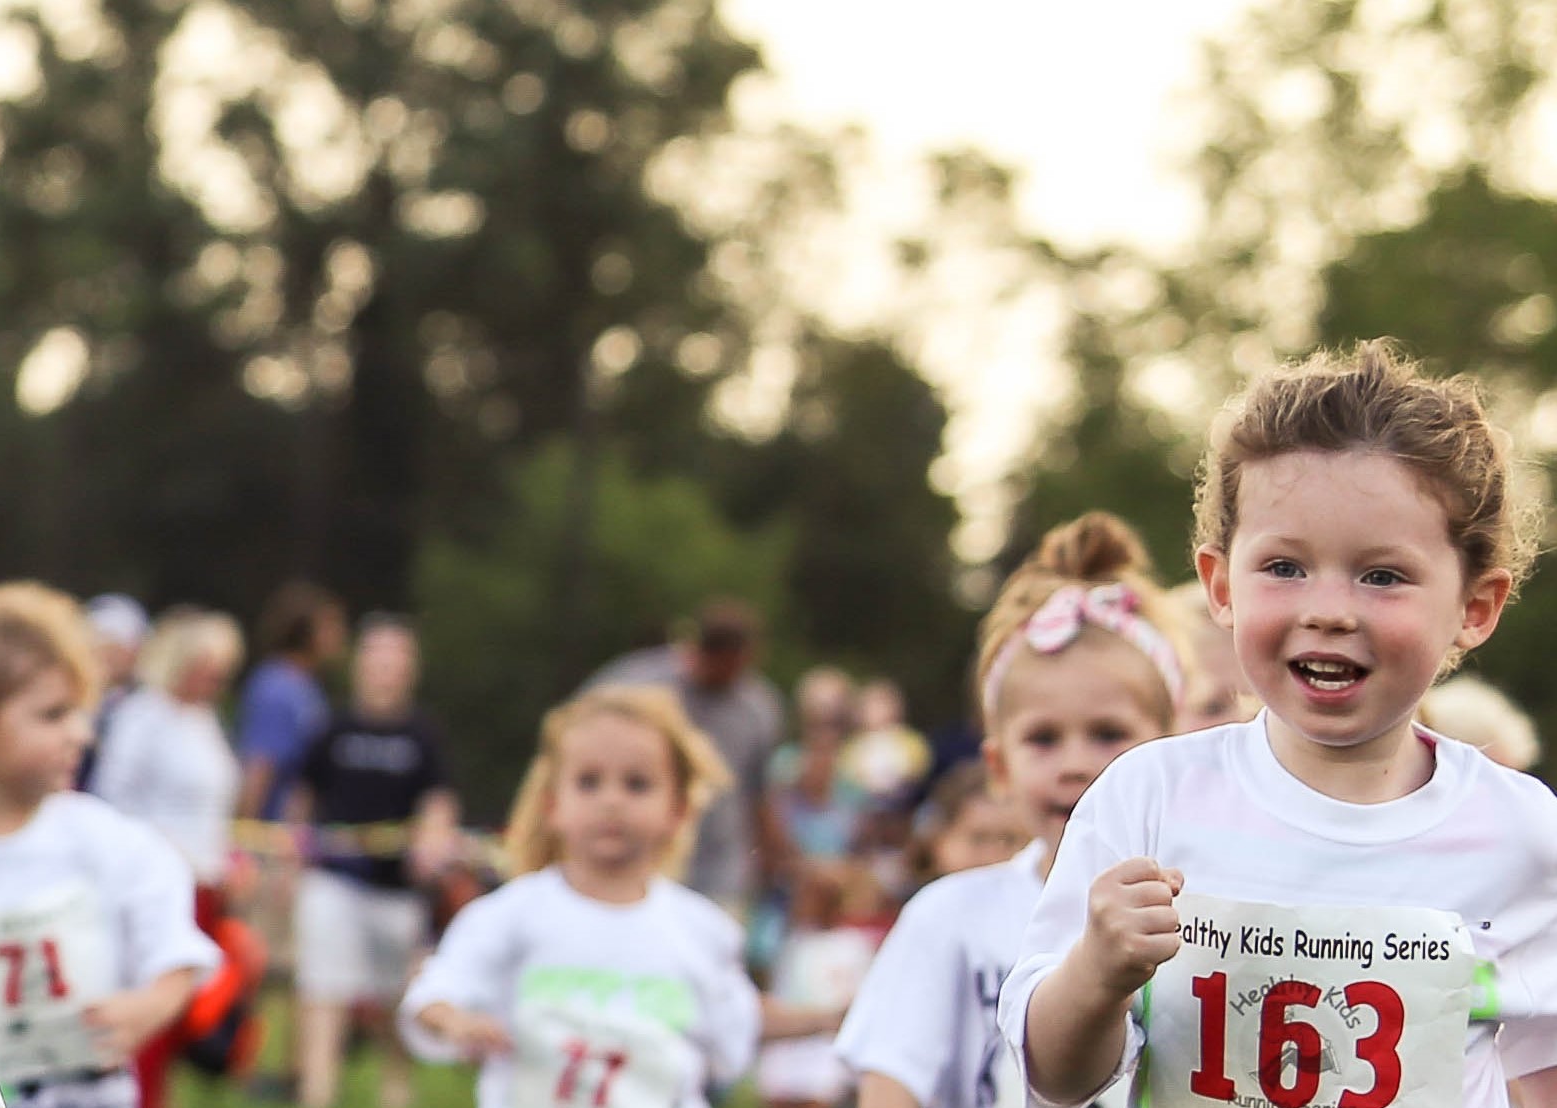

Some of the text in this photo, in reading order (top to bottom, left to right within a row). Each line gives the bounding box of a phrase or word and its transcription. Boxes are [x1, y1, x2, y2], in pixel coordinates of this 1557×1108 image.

[1240, 926, 1284, 956] Kids
[1294, 930, 1373, 969] Running
[1383, 932, 1450, 962] Series
[1322, 985, 1361, 1030] Kids
